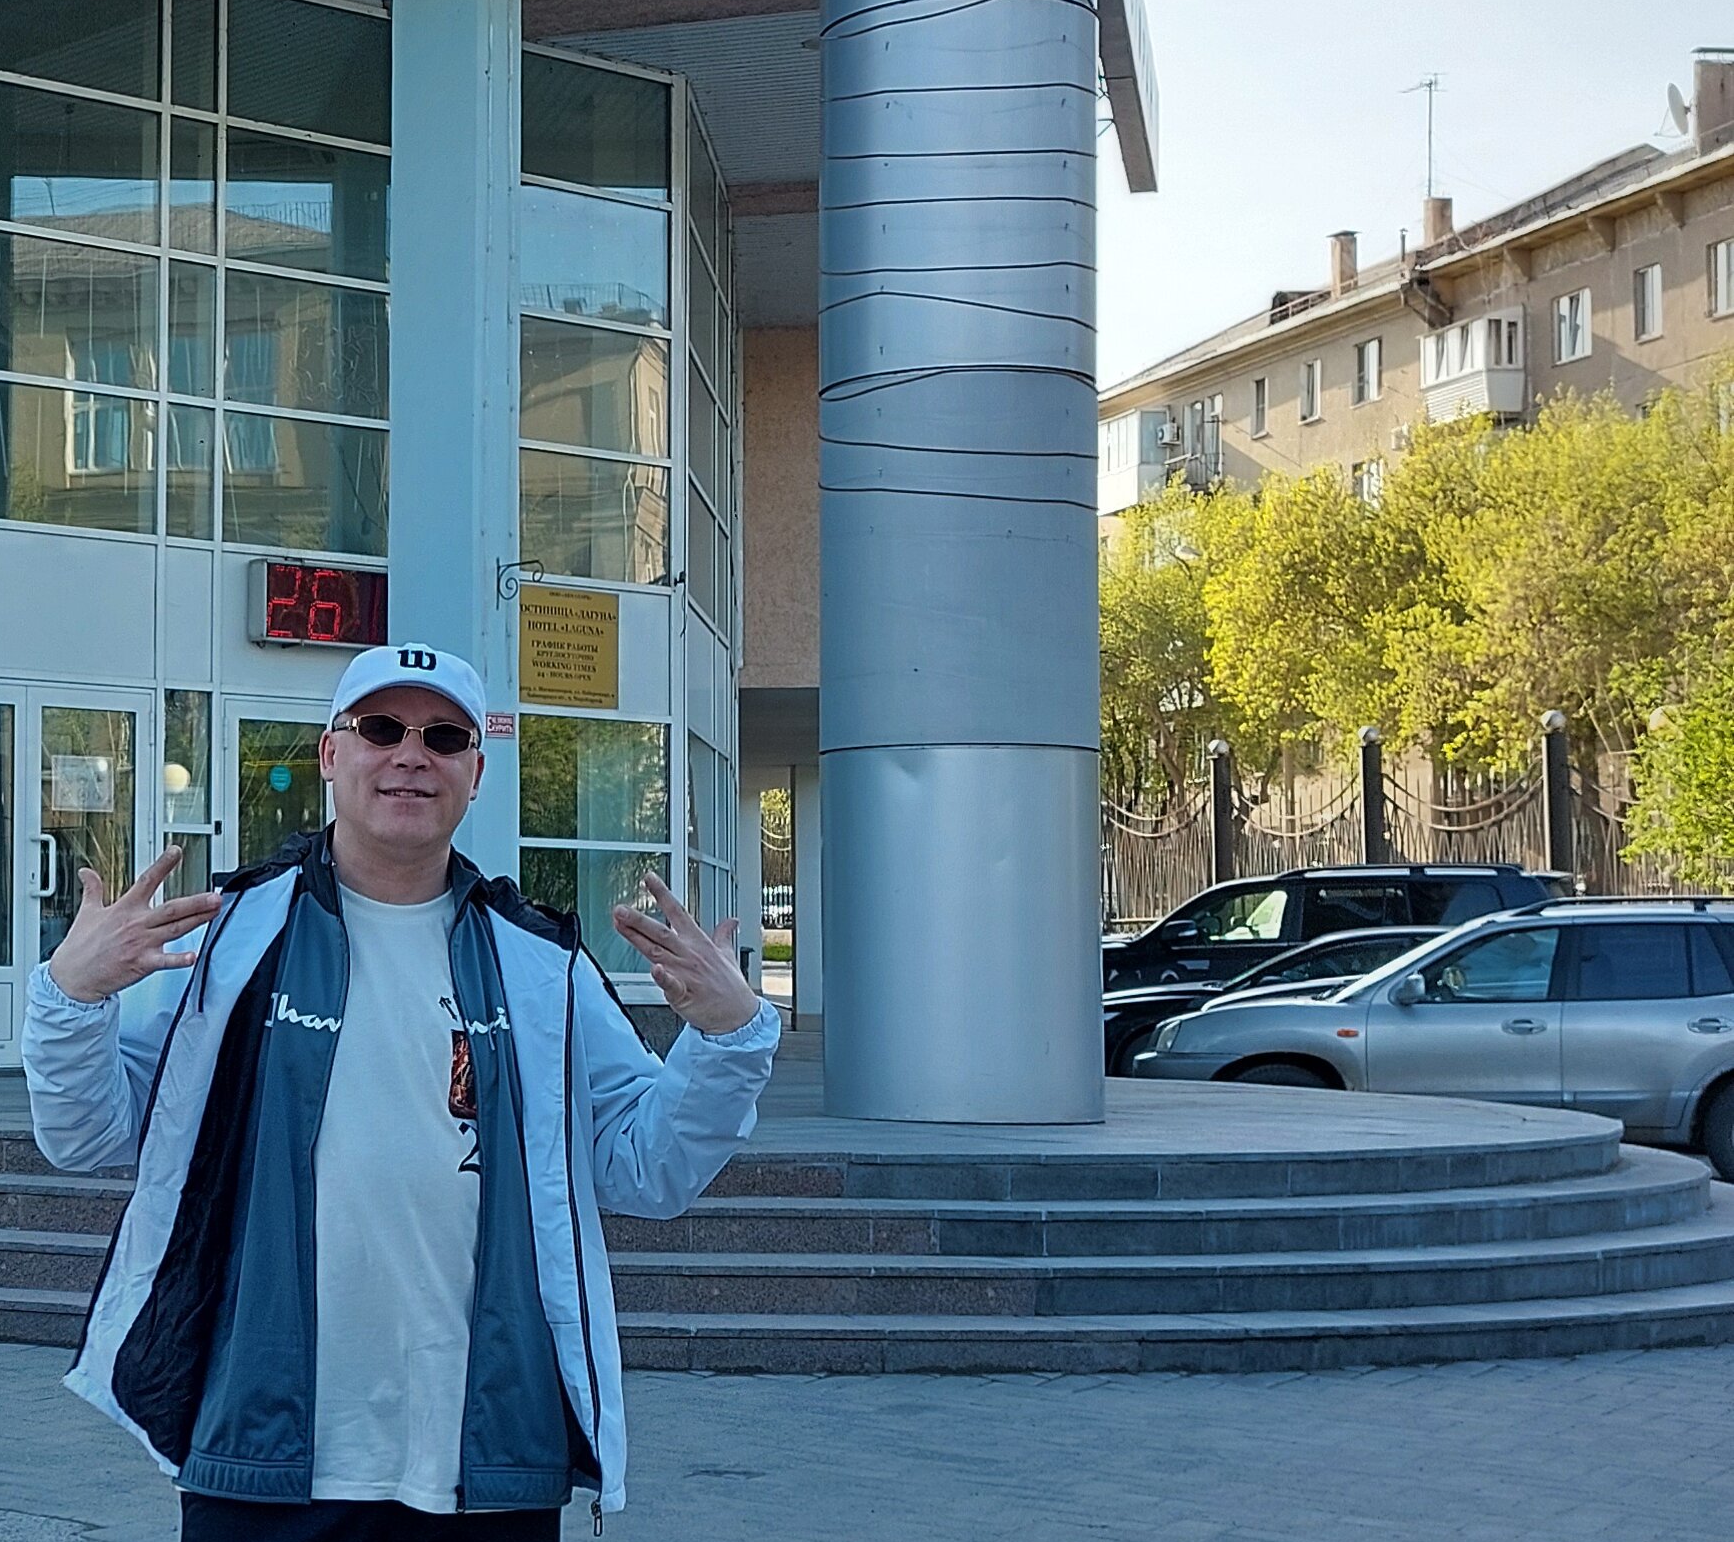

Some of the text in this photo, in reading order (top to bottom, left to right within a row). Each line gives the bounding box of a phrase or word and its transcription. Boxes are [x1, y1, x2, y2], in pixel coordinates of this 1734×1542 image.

[520, 604, 573, 618] ОСТИНИЦА
[527, 619, 559, 632] HOTEL
[531, 639, 599, 653] ГРАФИК РАБОТЫ
[532, 659, 597, 673] WORKING TIMES
